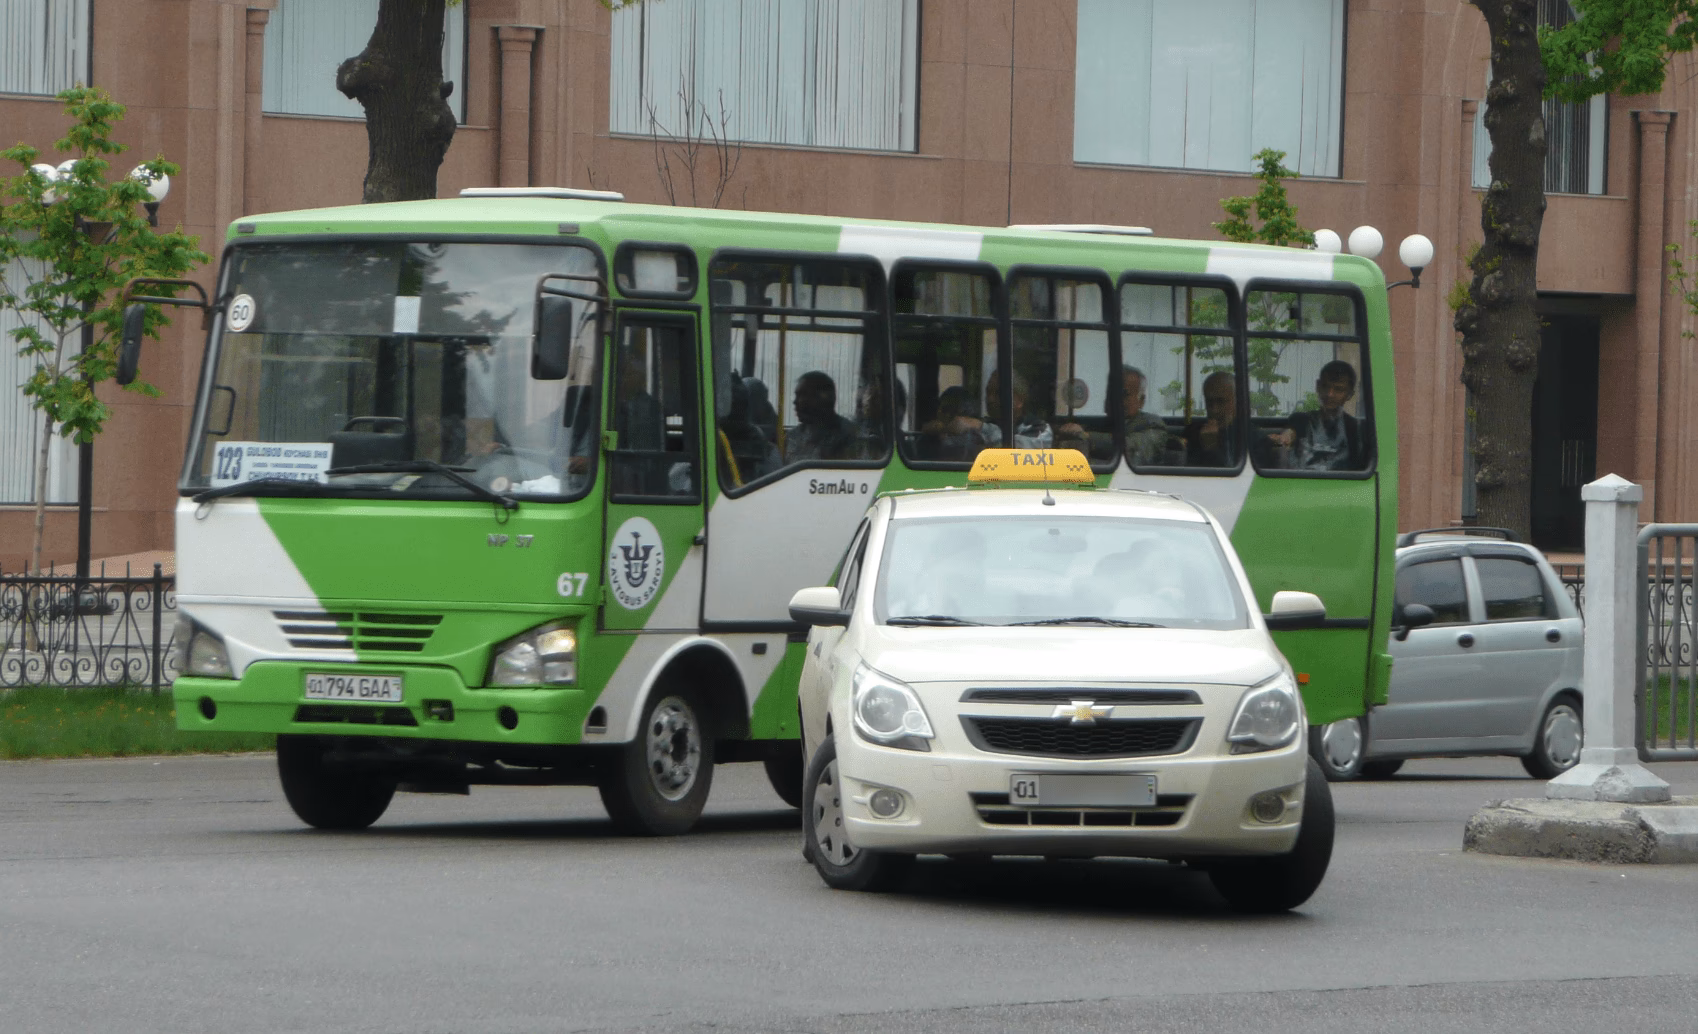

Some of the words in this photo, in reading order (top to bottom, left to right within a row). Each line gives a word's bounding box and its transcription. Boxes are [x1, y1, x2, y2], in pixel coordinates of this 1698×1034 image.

[232, 304, 249, 320] 60
[217, 446, 243, 480] 123
[1010, 453, 1055, 466] TAXI
[557, 572, 589, 597] 67
[308, 678, 324, 694] 01
[326, 677, 355, 697] 794
[360, 678, 391, 698] GAA
[1015, 780, 1038, 799] 01
